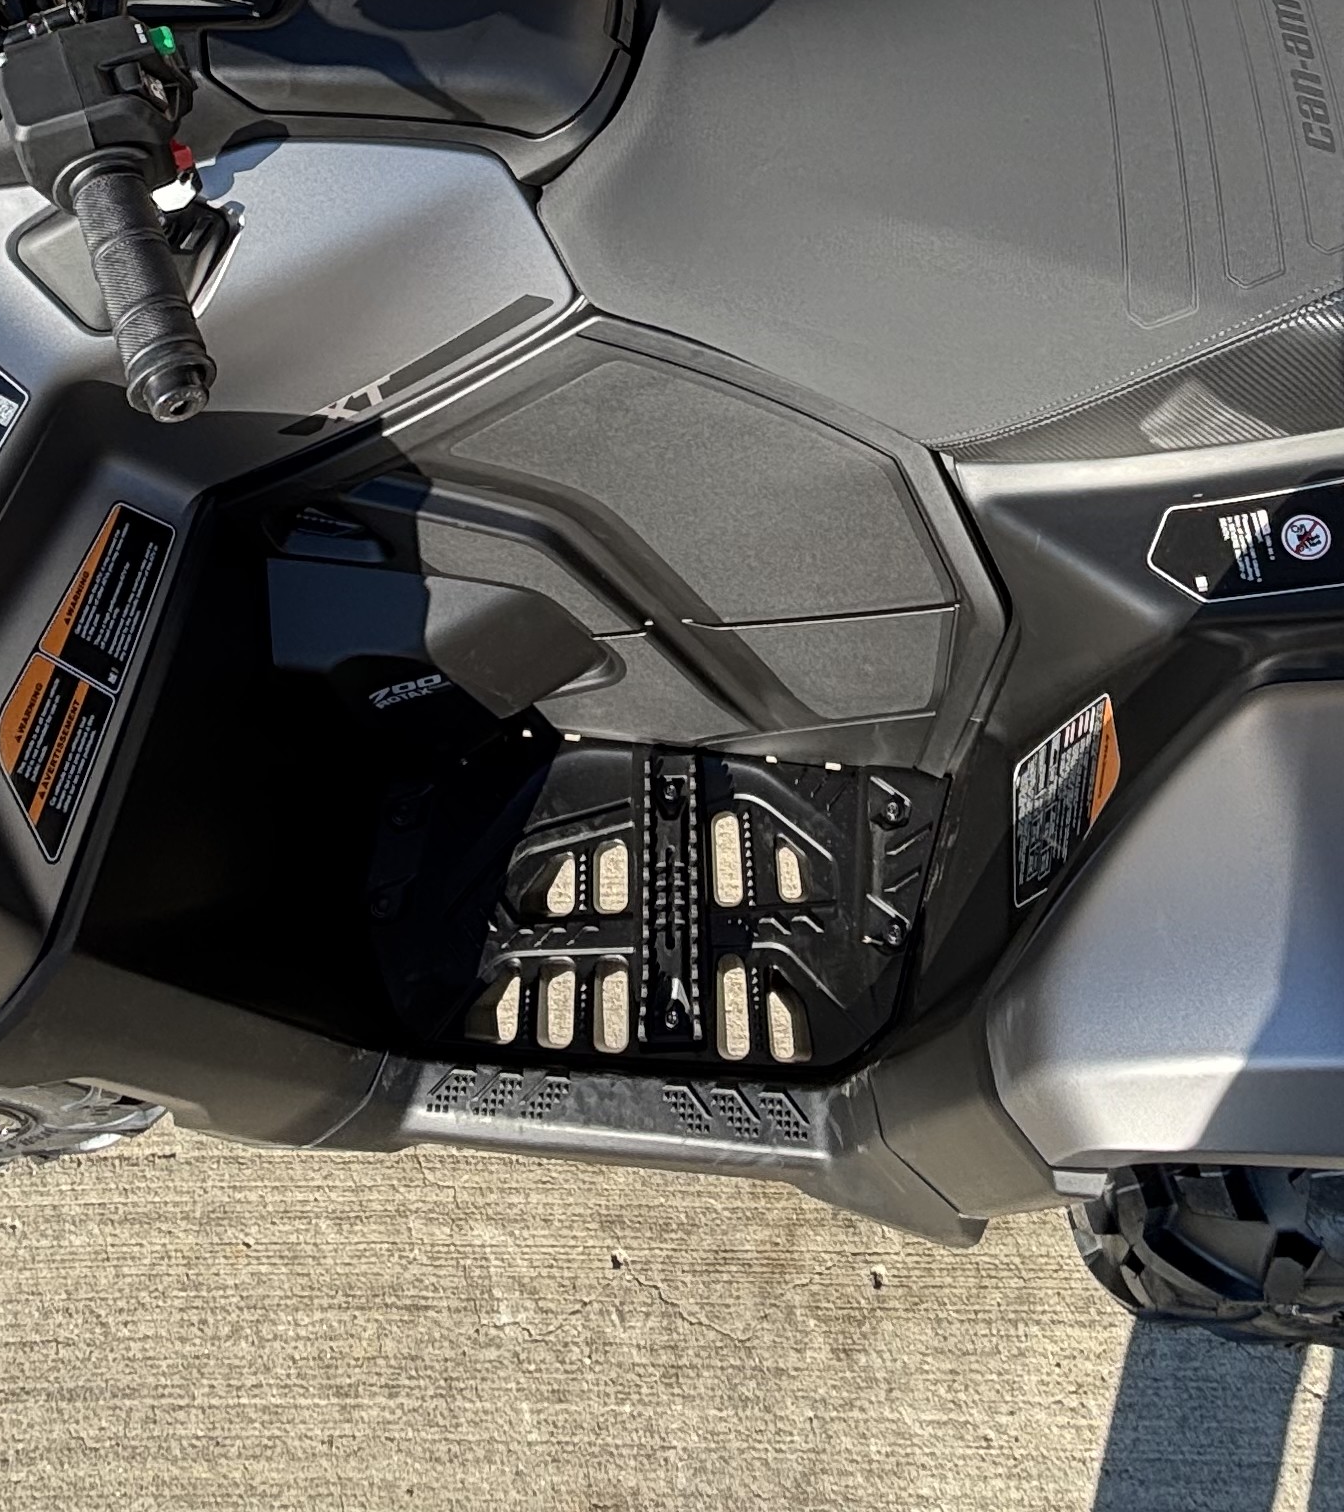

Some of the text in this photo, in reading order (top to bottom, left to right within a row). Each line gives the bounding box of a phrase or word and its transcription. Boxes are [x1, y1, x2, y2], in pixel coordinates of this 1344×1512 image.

[314, 374, 391, 423] XT
[66, 571, 89, 616] WARNING
[18, 682, 42, 733] WARNING
[368, 674, 442, 704] 700
[375, 687, 435, 709] ROTAX
[42, 699, 79, 788] AVERTISSEMENT
